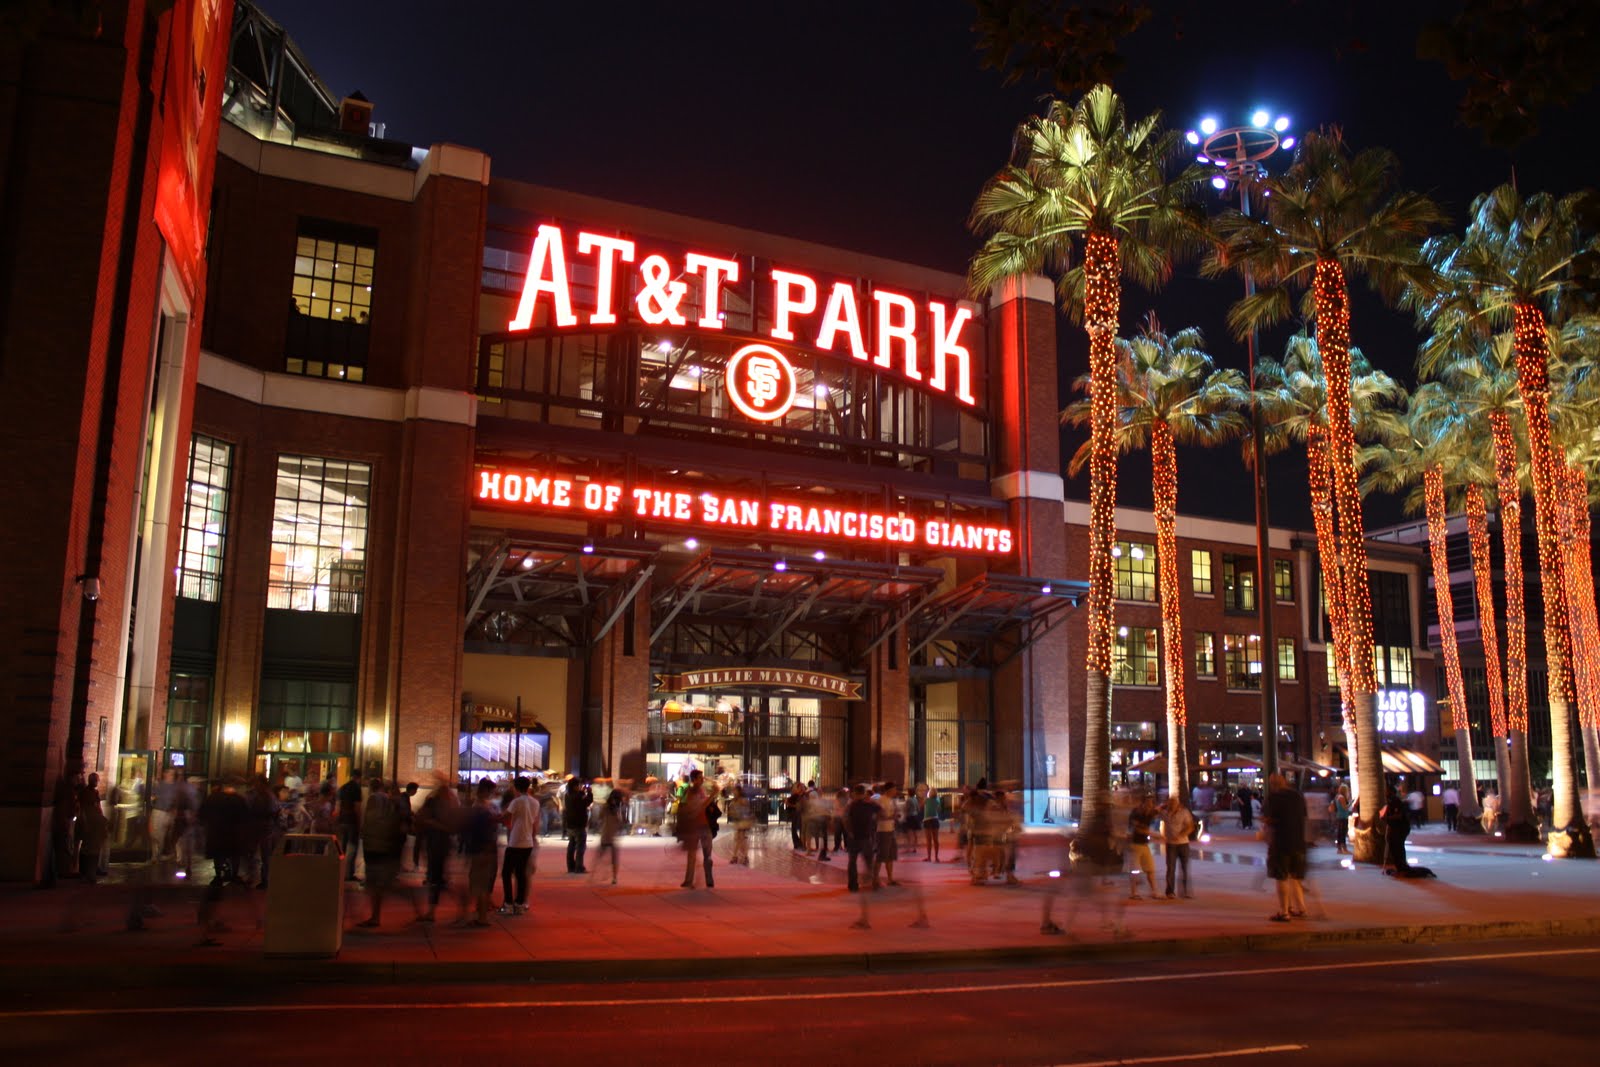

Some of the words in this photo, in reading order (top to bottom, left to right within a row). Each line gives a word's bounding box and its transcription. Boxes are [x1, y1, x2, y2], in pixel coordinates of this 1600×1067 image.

[508, 224, 739, 332] AT&T
[770, 269, 976, 405] PARK
[479, 471, 571, 507] HOME
[584, 483, 622, 512] OF
[633, 488, 691, 520] THE
[702, 495, 760, 526] SAN
[770, 503, 916, 542] FRANCISCO
[925, 520, 1012, 552] GIANTS
[687, 670, 753, 685] WILLIE
[759, 670, 804, 684] MAYS
[809, 675, 847, 693] GATE
[1377, 690, 1408, 711] LIC
